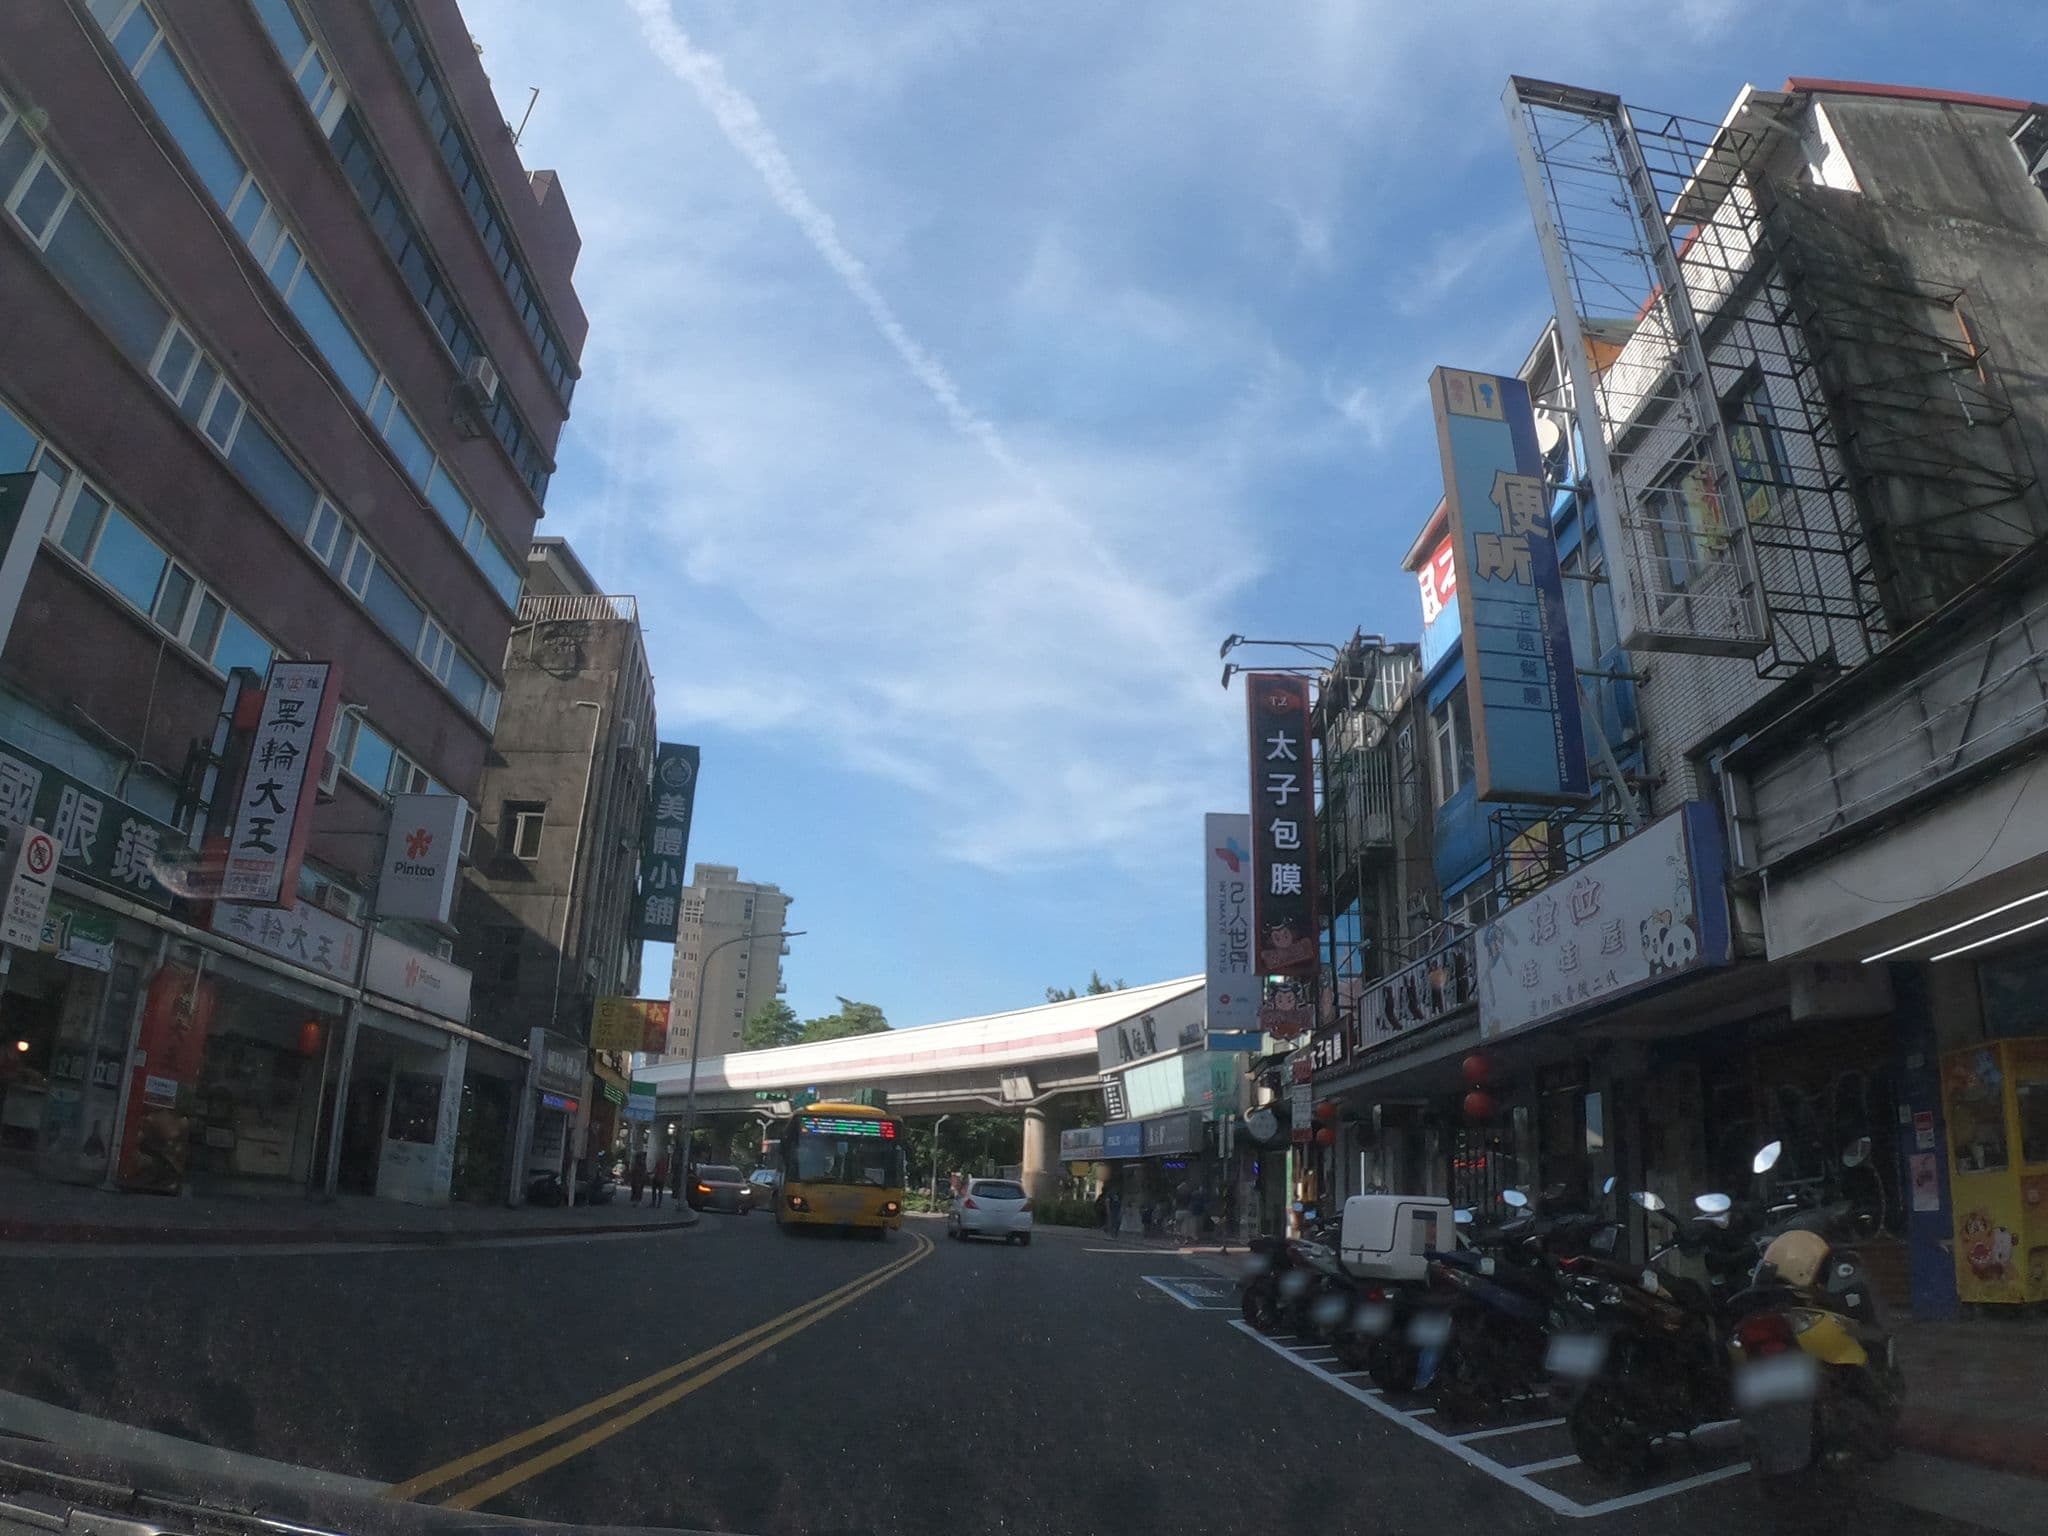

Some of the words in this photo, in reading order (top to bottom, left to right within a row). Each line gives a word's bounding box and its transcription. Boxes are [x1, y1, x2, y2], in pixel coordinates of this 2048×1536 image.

[1473, 469, 1549, 586] 便所
[1551, 669, 1560, 710] Theme
[239, 698, 306, 855] 黑輪大王
[1266, 729, 1303, 896] 太子包膜
[644, 791, 686, 926] 美體小舖
[230, 905, 334, 971] 黑輪大王
